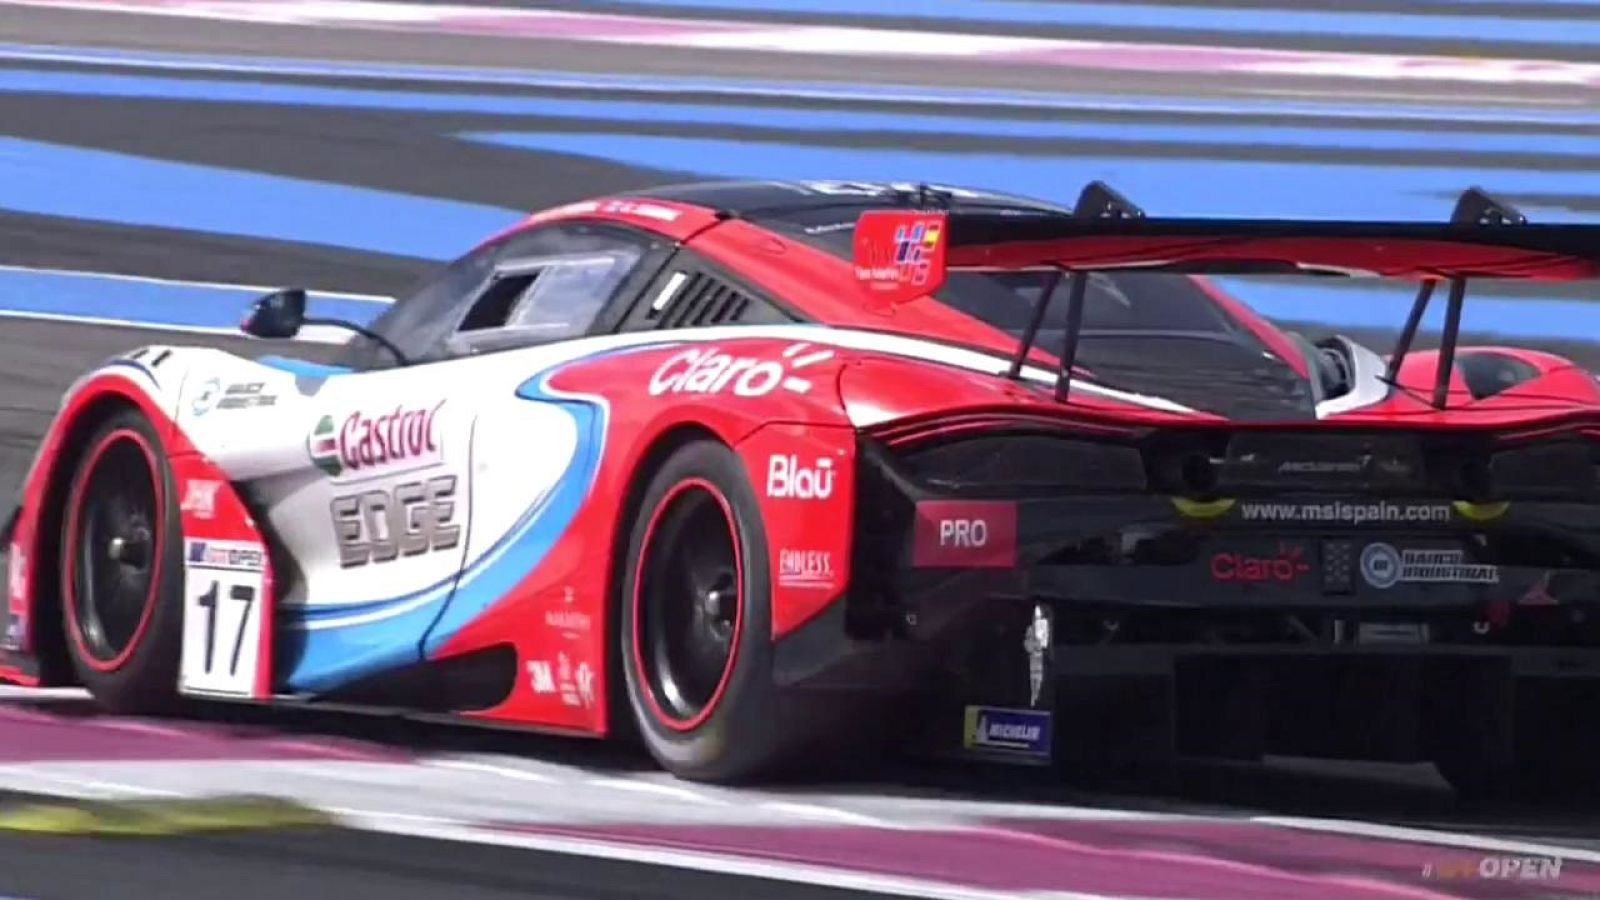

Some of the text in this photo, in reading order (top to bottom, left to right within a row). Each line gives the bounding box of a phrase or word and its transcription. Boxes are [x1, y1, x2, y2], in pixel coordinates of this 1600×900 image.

[649, 348, 784, 396] Claro
[340, 398, 447, 470] Castrol
[330, 474, 461, 569] EDGE
[939, 519, 988, 547] PRO
[1241, 500, 1451, 525] www.msispain.com
[1210, 552, 1294, 581] Claro
[197, 580, 256, 677] 17
